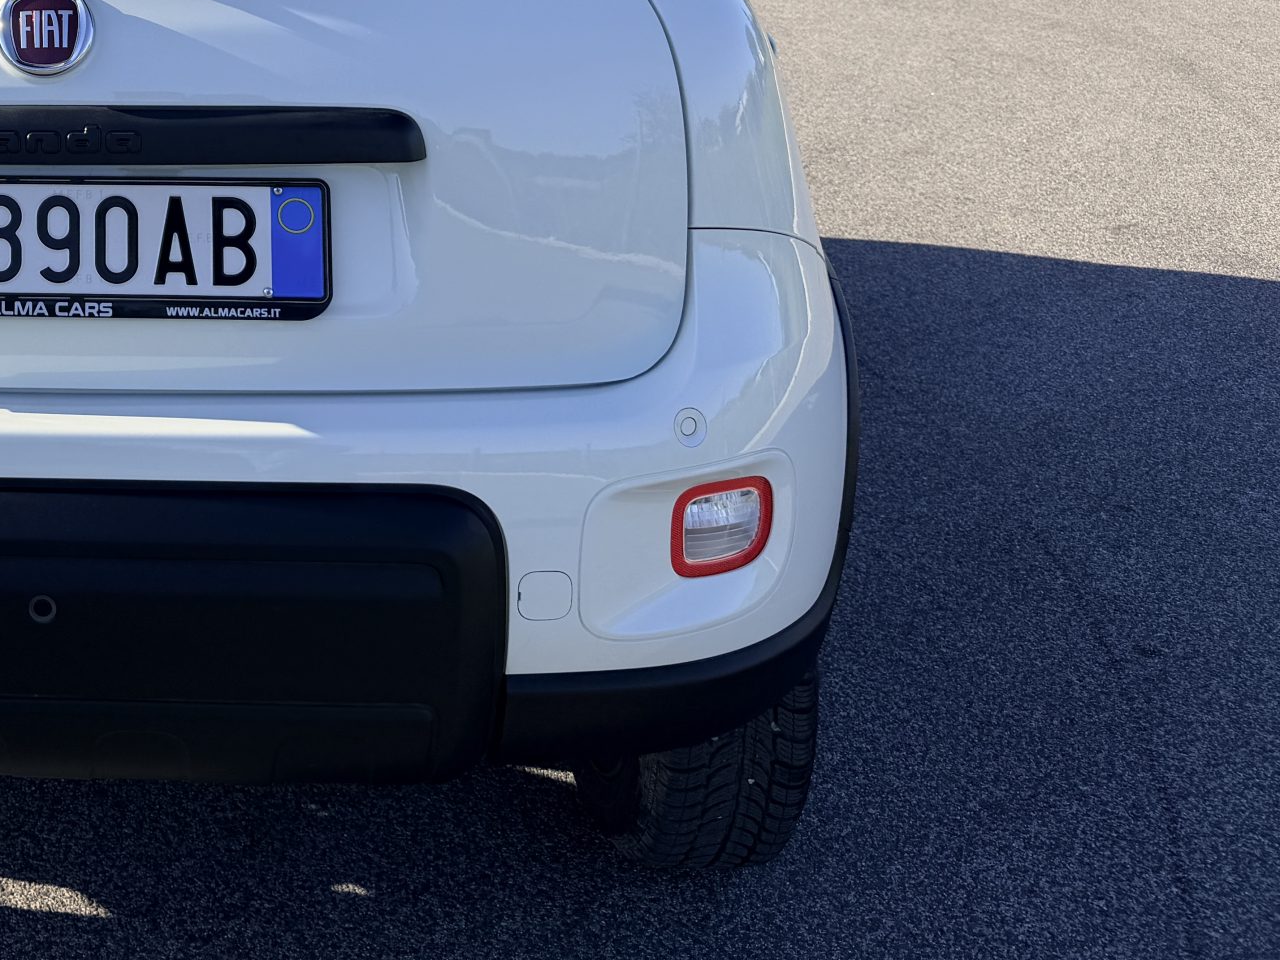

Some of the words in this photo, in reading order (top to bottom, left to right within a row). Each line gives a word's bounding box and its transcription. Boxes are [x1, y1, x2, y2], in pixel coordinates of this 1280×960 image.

[19, 9, 74, 49] FIAT
[55, 301, 113, 318] CARS
[166, 305, 282, 319] WWW.ALMACARS.IT
